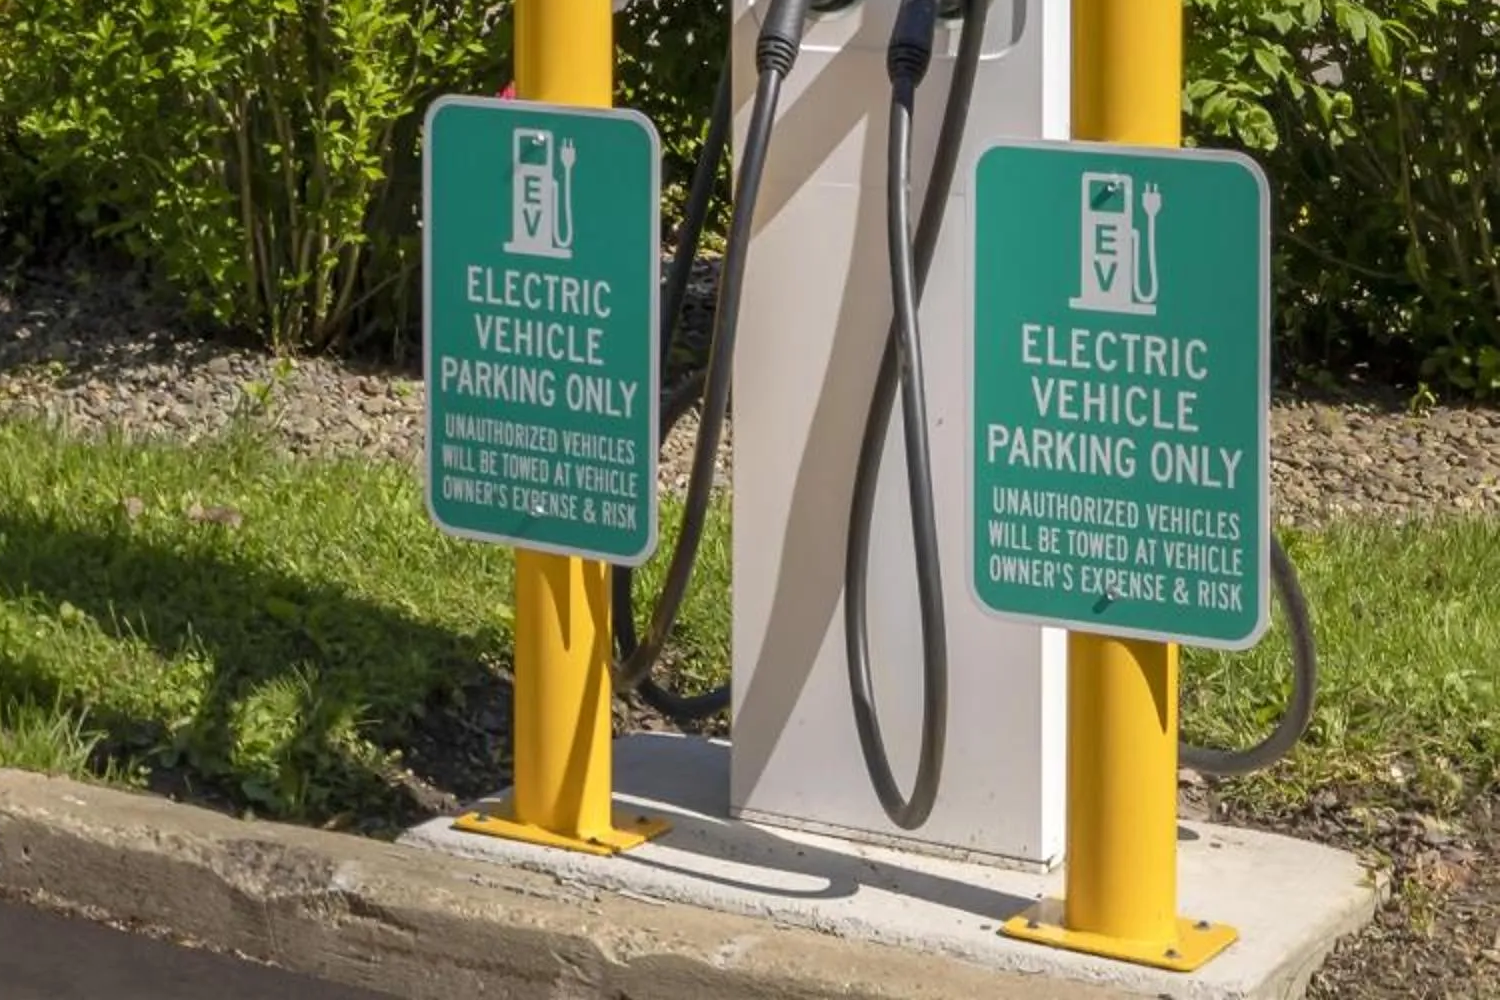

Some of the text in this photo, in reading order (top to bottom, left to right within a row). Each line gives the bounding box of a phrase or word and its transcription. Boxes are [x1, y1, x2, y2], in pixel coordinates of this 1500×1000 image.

[522, 175, 542, 238] EV
[1093, 223, 1118, 292] EV
[468, 265, 611, 318] ELECTRIC
[474, 314, 604, 365] VEHICLE
[1022, 323, 1207, 380] ELECTRIC
[441, 357, 637, 418] PARKING ONLY
[1031, 376, 1199, 432] VEHICLE
[445, 413, 635, 465] UNAUTHORIZED VEHICLES
[988, 423, 1242, 489] PARKING ONLY
[442, 444, 638, 498] WILL BE TOWED AT VEHICLE
[443, 475, 637, 531] OWNER'S EXPENSE & RISK
[993, 487, 1240, 541] UNAUTHORIZED VEHICLES
[988, 520, 1243, 576] WILL BE TOWED AT VEHICLE
[989, 555, 1243, 611] OWNER'S EXPENSE & RISK
